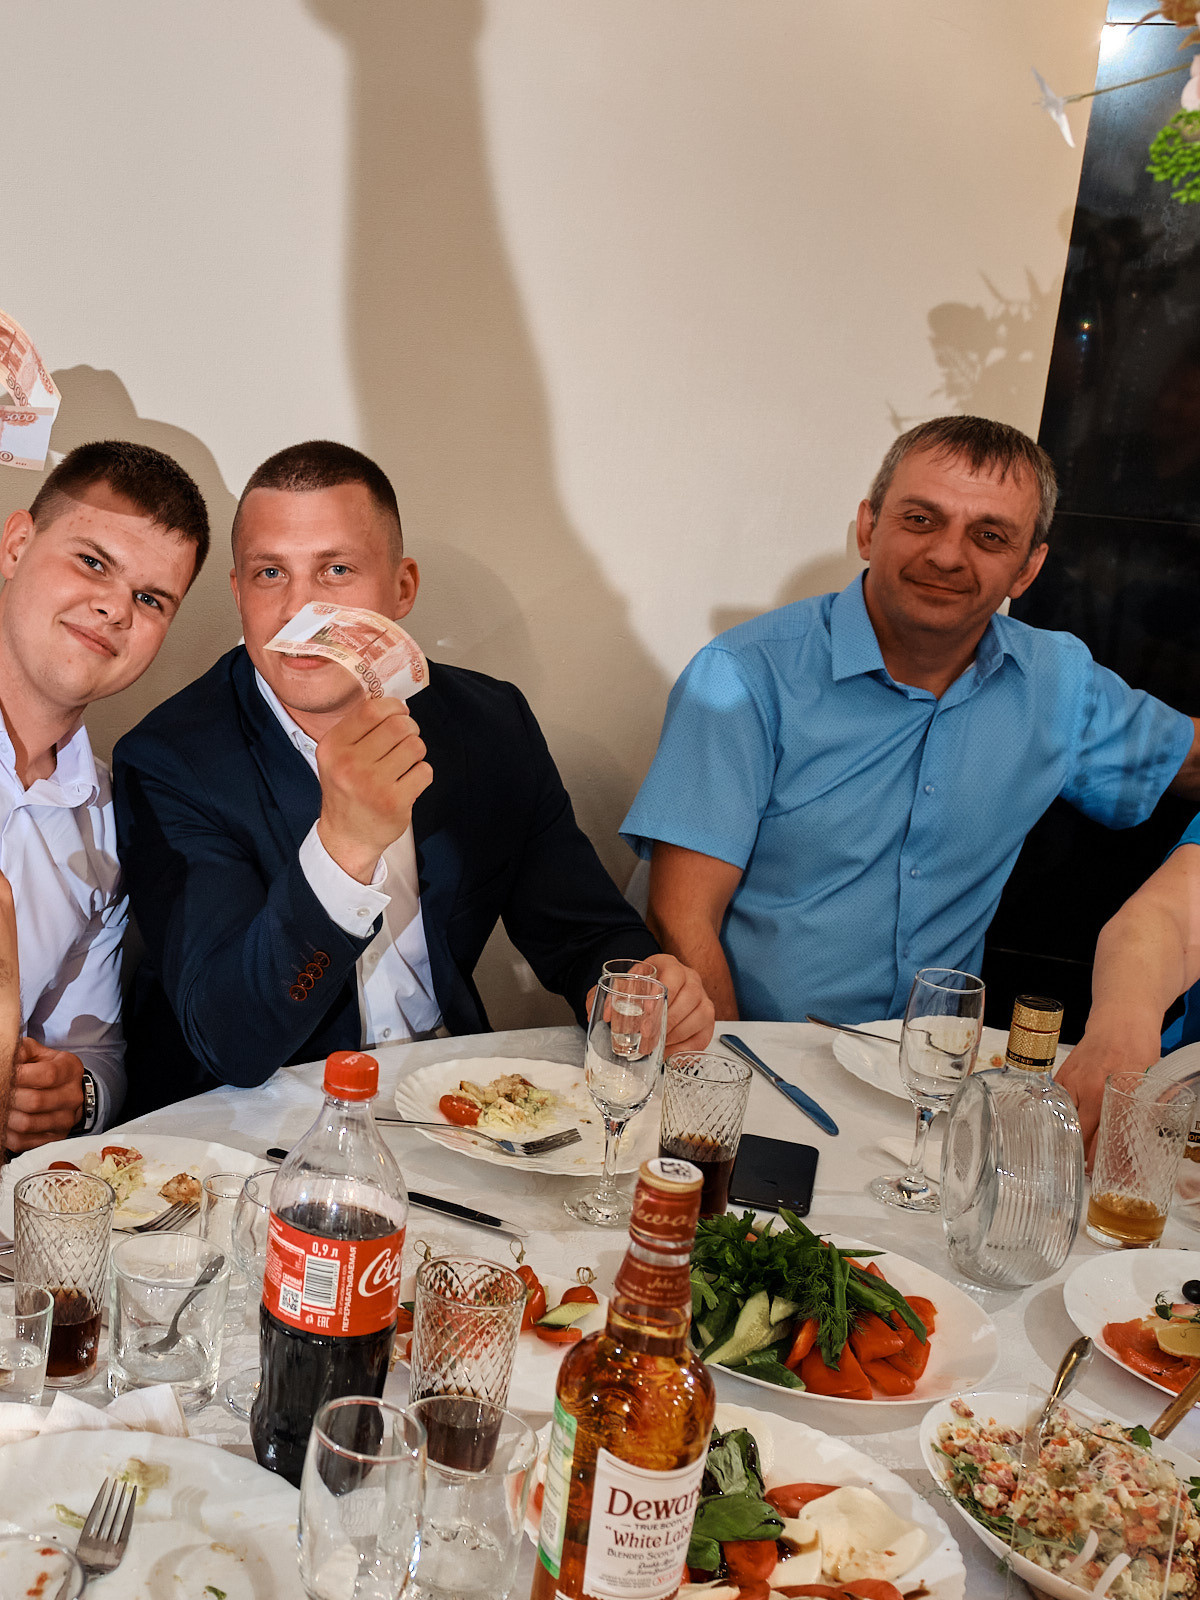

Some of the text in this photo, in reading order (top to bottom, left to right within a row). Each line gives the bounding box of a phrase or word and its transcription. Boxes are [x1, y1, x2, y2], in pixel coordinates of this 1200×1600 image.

[4, 412, 37, 423] 5000
[312, 1242, 339, 1258] 0,9 л
[342, 1245, 357, 1332] ПЕРЕРАБАТЫВАЕМАЯ
[635, 1523, 659, 1531] TRUE
[607, 1548, 644, 1560] BLENDED
